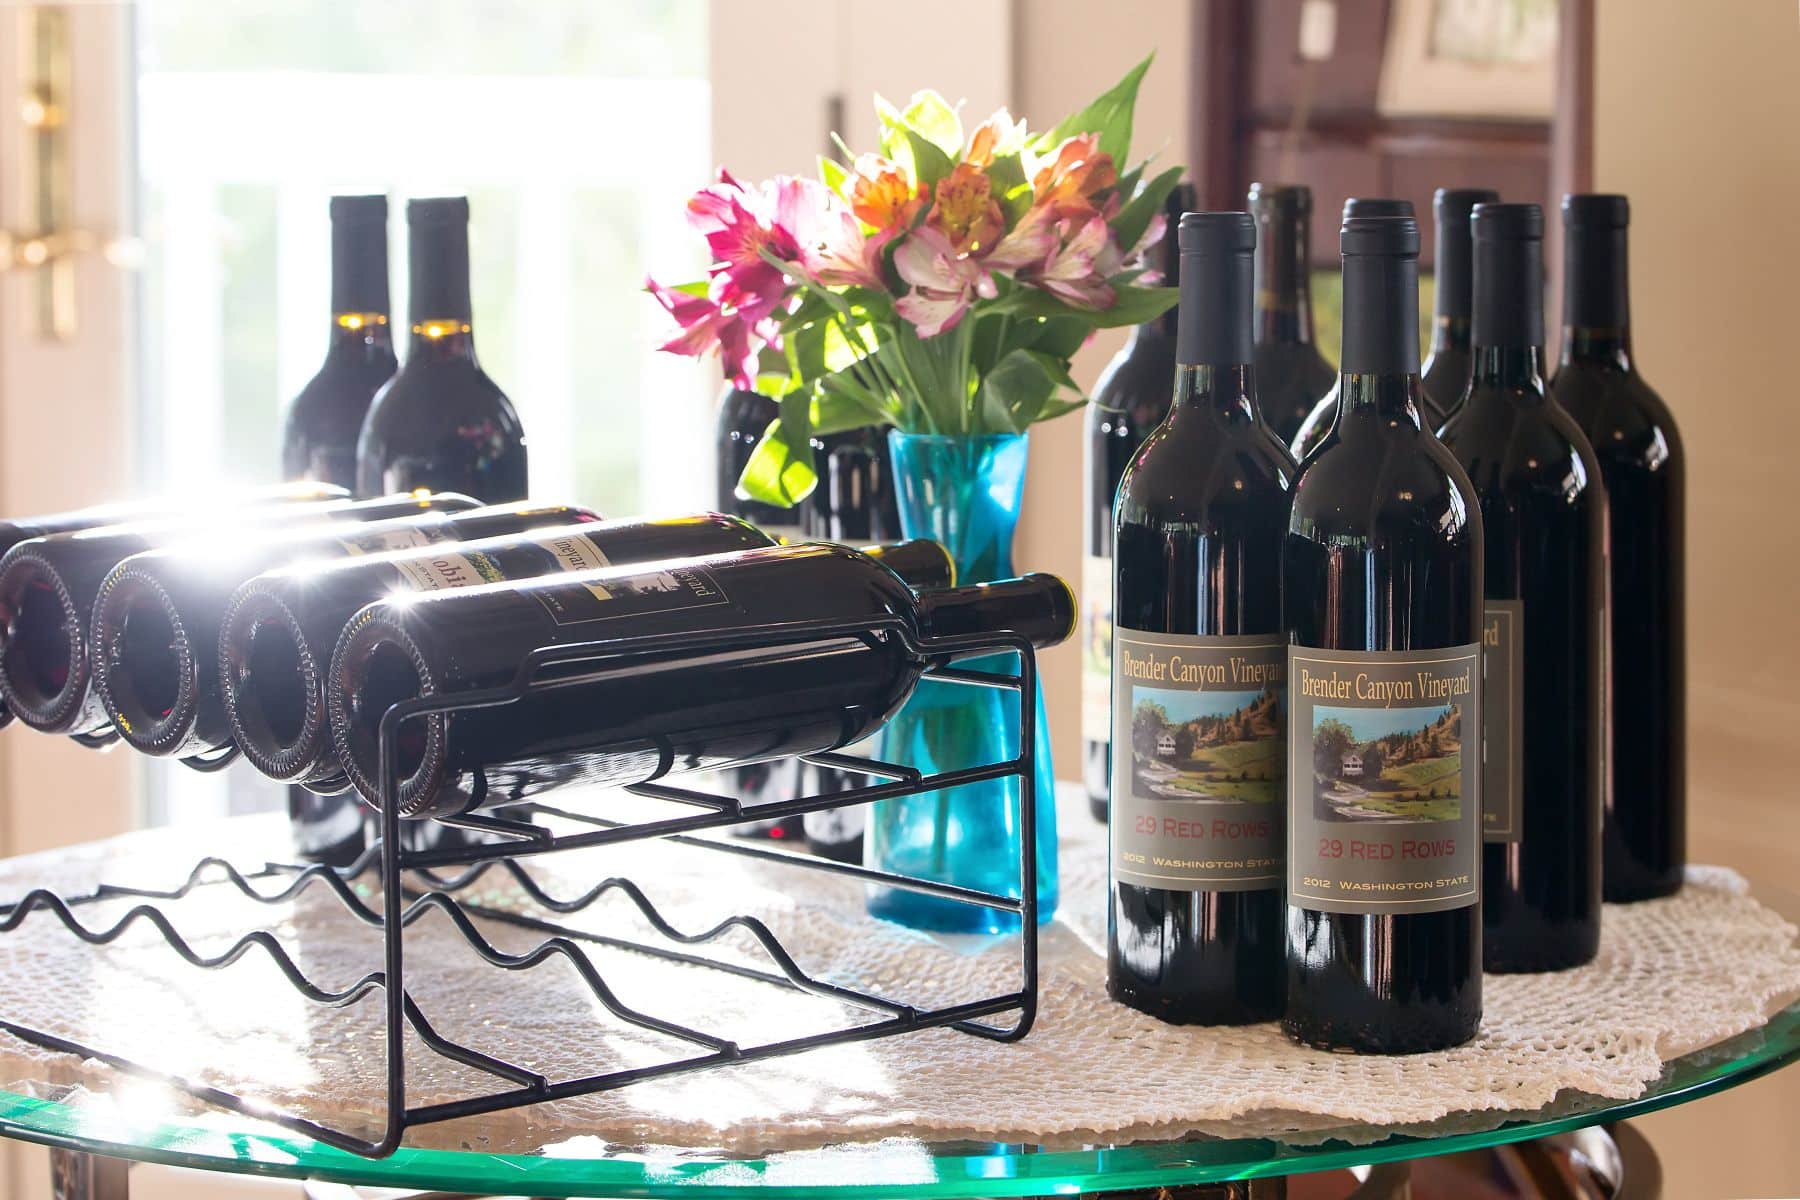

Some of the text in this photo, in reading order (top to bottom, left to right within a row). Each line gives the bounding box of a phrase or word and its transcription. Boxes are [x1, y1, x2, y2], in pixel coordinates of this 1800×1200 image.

[1123, 650, 1281, 692] Brender Canyon Vineyar
[1301, 667, 1471, 711] Brender Canyon Vineyard
[1135, 815, 1270, 840] 29 RED ROWS
[1318, 838, 1456, 860] 29 RED ROWS
[1152, 857, 1244, 869] WASHINGTON
[1246, 858, 1278, 869] STAT
[1303, 875, 1469, 891] 2012 WASHINGTON STATE
